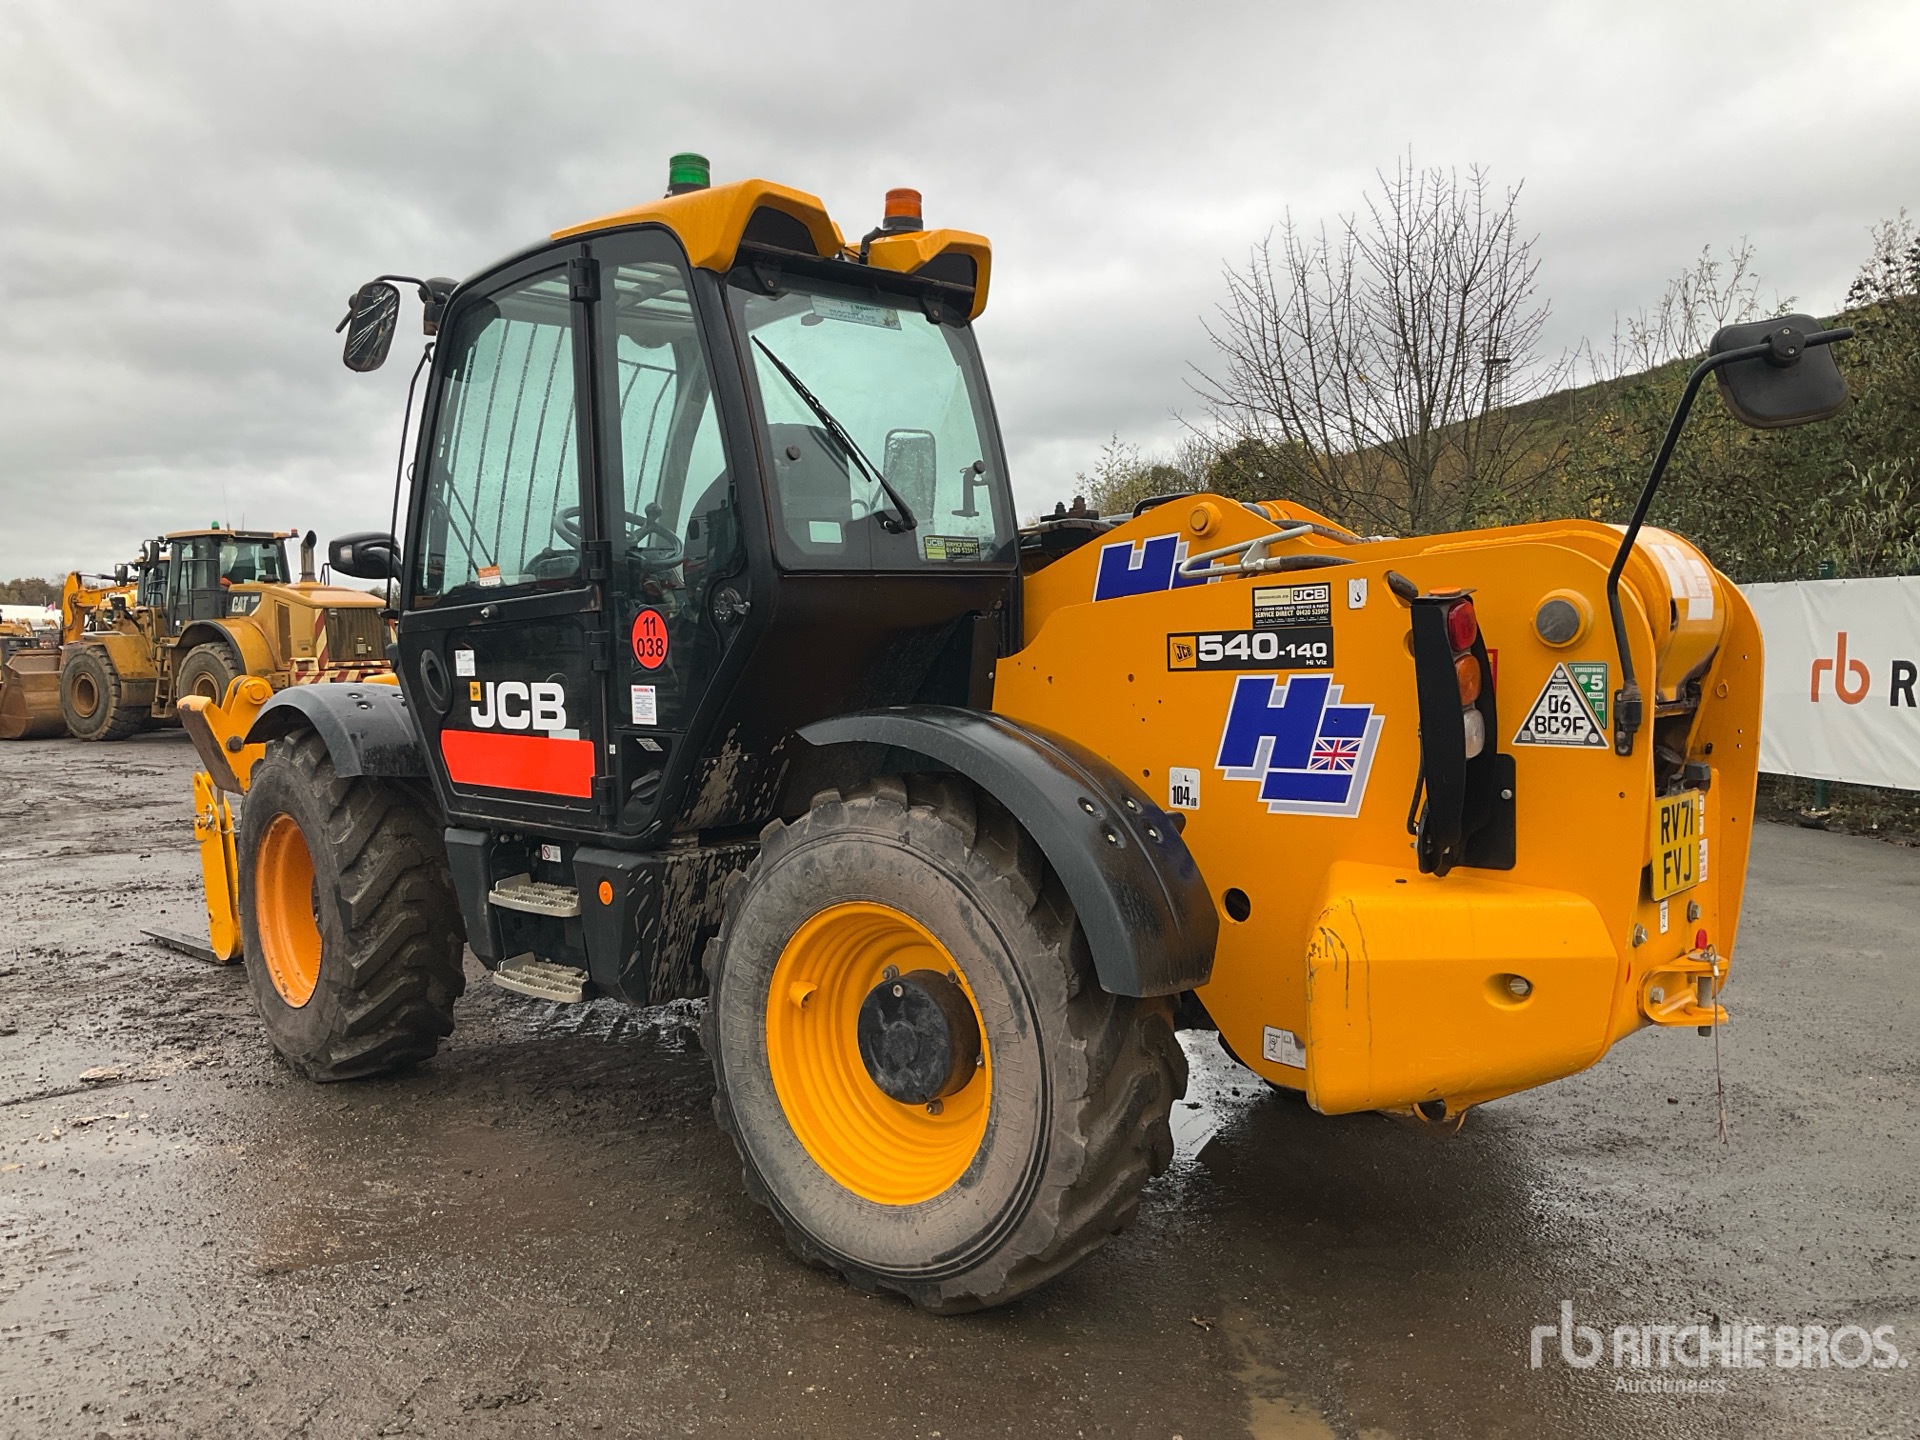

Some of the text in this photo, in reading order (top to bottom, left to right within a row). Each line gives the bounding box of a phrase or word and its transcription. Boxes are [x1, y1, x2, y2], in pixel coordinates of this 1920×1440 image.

[231, 595, 250, 613] CAT
[1294, 589, 1325, 601] JCB
[1254, 610, 1275, 618] SERVICE
[1275, 609, 1294, 617] DIRECT
[643, 616, 656, 637] 11
[636, 637, 664, 658] 038
[1173, 643, 1193, 662] JCB
[1810, 631, 1871, 705] rb
[1590, 674, 1604, 691] 5
[470, 681, 567, 731] JCB
[1534, 715, 1585, 735] BC9F
[1172, 785, 1190, 805] 104
[1661, 798, 1694, 845] RV71
[1663, 843, 1692, 890] FVJ
